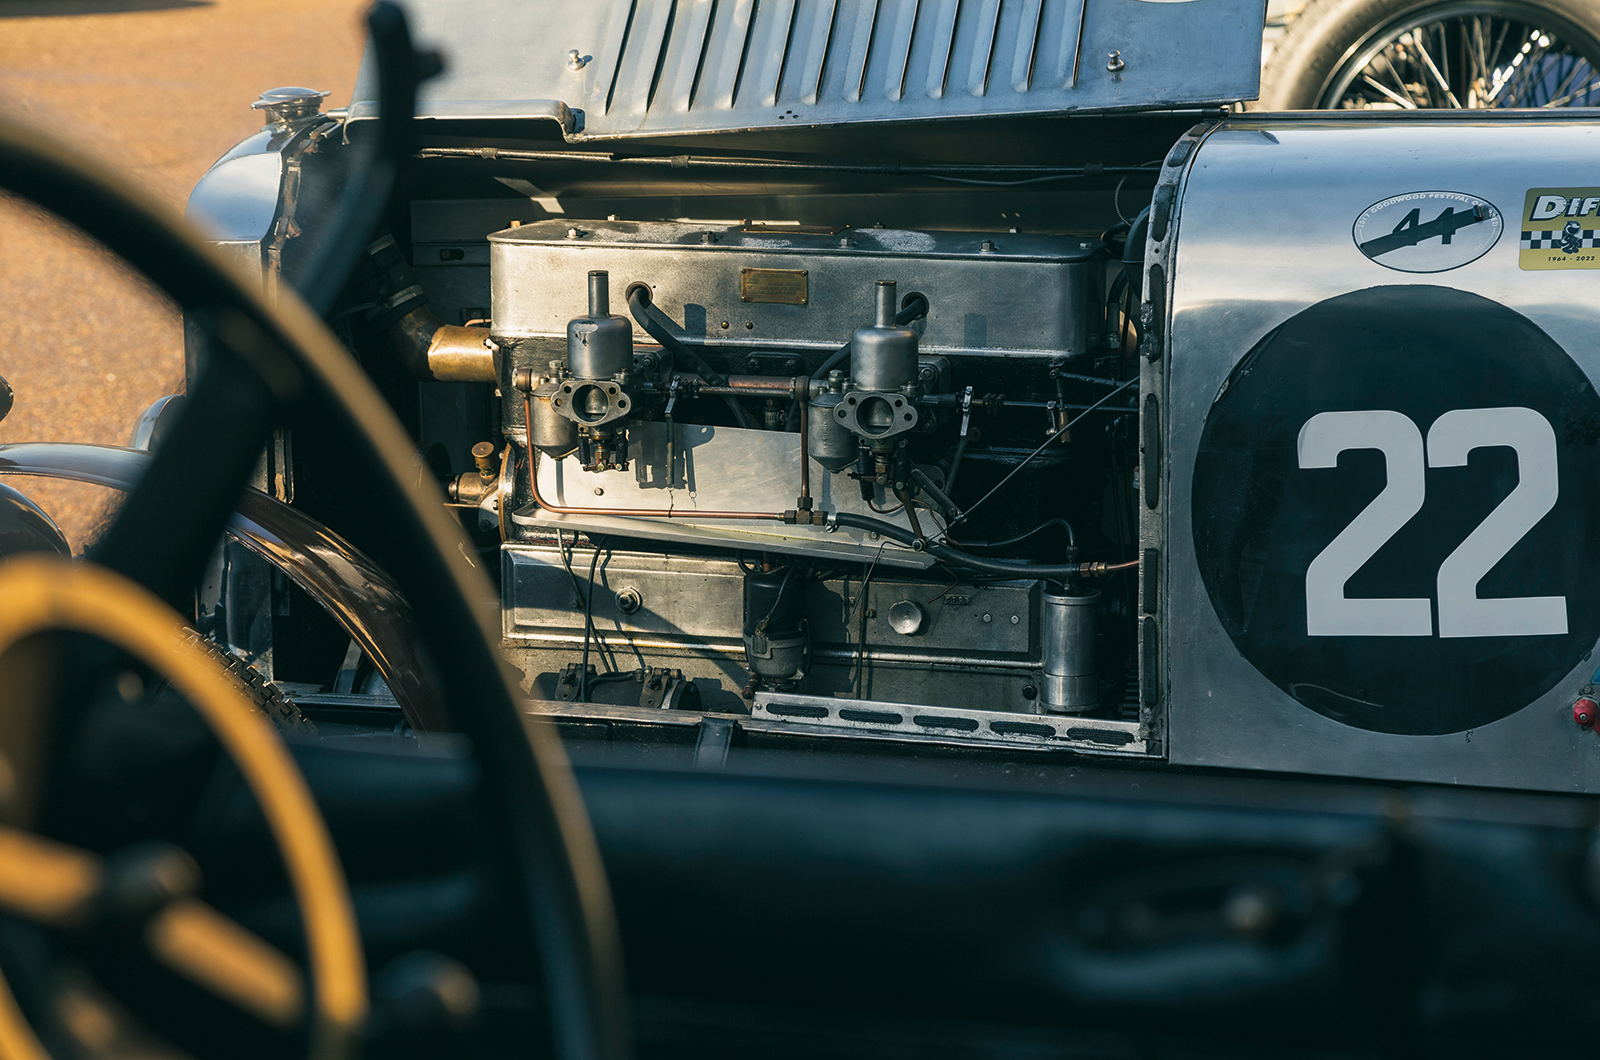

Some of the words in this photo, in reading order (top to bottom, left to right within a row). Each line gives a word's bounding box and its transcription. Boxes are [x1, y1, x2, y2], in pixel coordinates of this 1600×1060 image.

[1358, 213, 1371, 228] 2017
[1370, 194, 1426, 213] GOODWOOD
[1429, 194, 1469, 203] FESTIVAL
[1297, 406, 1569, 638] 22
